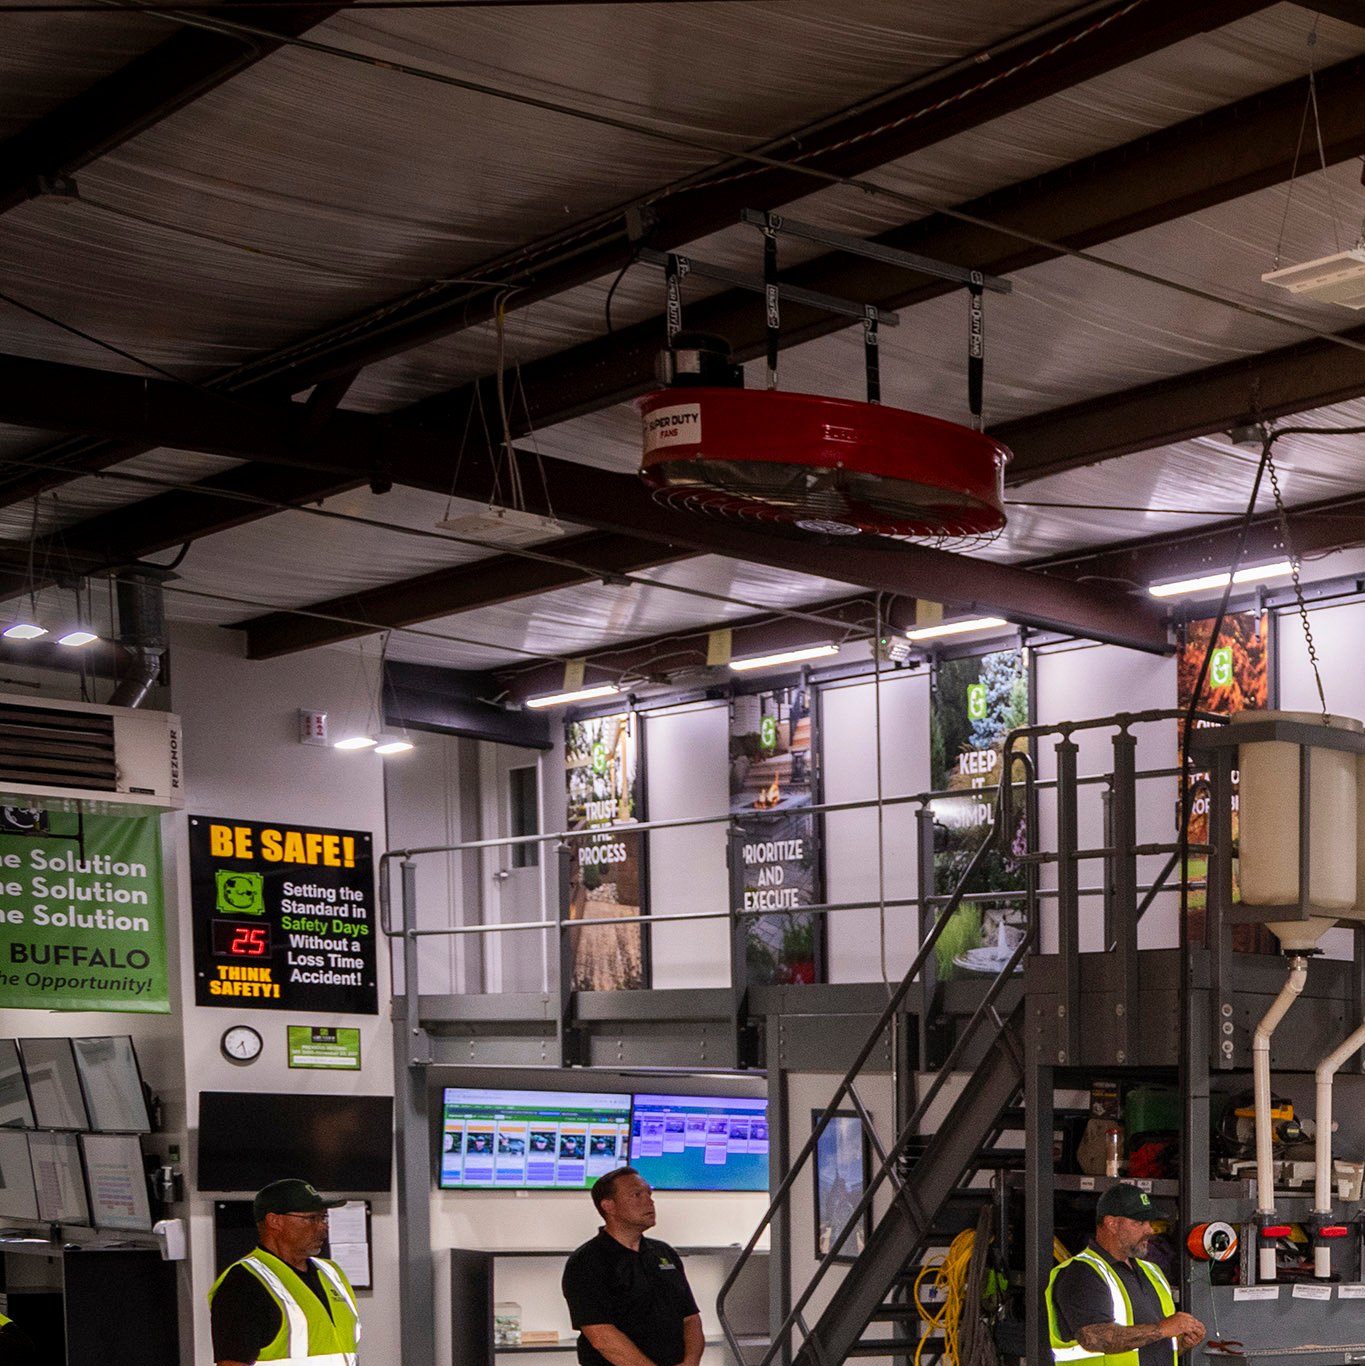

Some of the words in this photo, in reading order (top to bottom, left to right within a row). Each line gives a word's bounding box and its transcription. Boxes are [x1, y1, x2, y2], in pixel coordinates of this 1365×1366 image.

[671, 413, 698, 426] DUTY
[660, 428, 679, 438] FANS
[169, 729, 179, 788] REZNOR
[959, 749, 998, 774] KEEP
[584, 798, 618, 820] TRUST
[953, 803, 995, 828] SIMPL
[210, 825, 254, 859] BE
[260, 829, 355, 868] SAFE!
[578, 842, 627, 866] PROCESS
[30, 848, 147, 878] Solution
[757, 865, 785, 887] AND
[31, 876, 148, 905] Solution
[283, 882, 337, 902] Setting
[339, 886, 364, 901] the
[744, 887, 800, 912] EXECUTE
[33, 904, 150, 932] Solution
[281, 899, 349, 918] Standard
[352, 906, 367, 919] in
[281, 916, 328, 935] Safety
[332, 920, 370, 938] Days
[231, 928, 266, 955] 25
[289, 934, 349, 951] Without
[351, 942, 361, 952] a
[10, 943, 151, 970] BUFFALO
[288, 951, 324, 966] Loss
[327, 954, 364, 969] Time
[25, 972, 153, 994] Opportunity!
[216, 965, 272, 982] THINK
[290, 968, 362, 986] Accident!
[209, 980, 281, 998] SAFETY!
